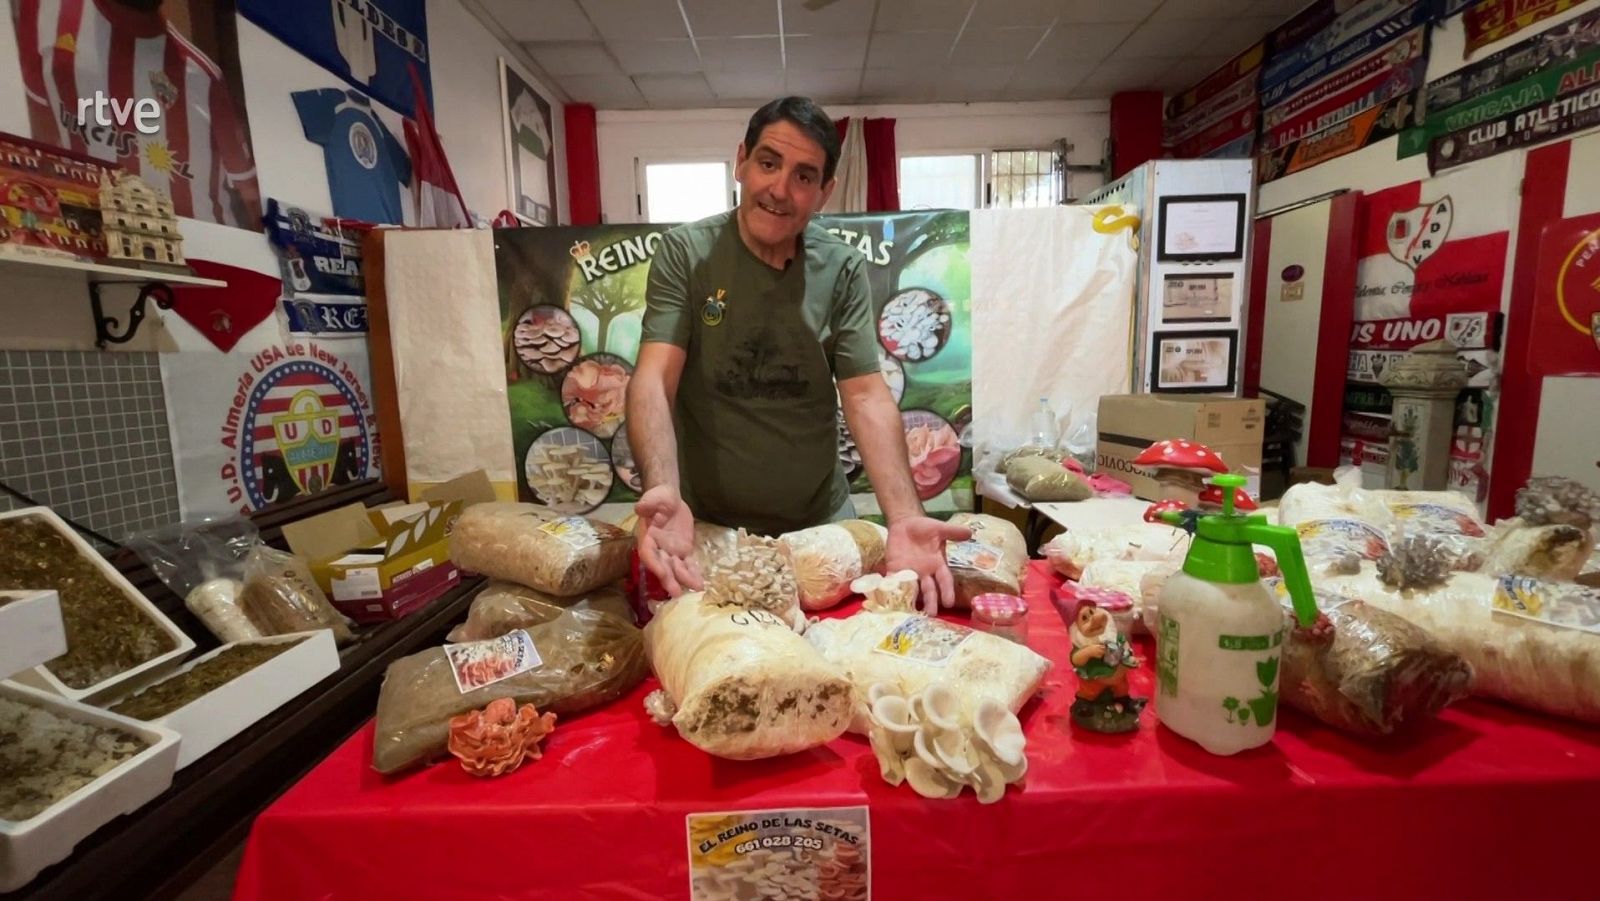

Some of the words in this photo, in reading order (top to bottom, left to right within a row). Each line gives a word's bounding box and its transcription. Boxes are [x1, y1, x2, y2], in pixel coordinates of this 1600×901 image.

[1468, 120, 1507, 146] CLUB
[313, 255, 359, 276] REA
[577, 231, 662, 282] REINO
[827, 228, 894, 266] TAS
[1383, 317, 1441, 342] UNO
[250, 344, 285, 373] USA
[286, 342, 305, 357] de
[309, 342, 339, 368] New
[284, 422, 297, 440] U
[321, 419, 332, 435] D
[1098, 454, 1155, 479] OCOVIC
[698, 837, 717, 854] EL
[716, 819, 758, 844] REINO
[762, 818, 781, 829] DE
[784, 817, 812, 829] LAS
[815, 821, 859, 846] SETAS
[735, 838, 762, 855] 661
[762, 836, 792, 848] 028
[792, 836, 824, 851] 205
